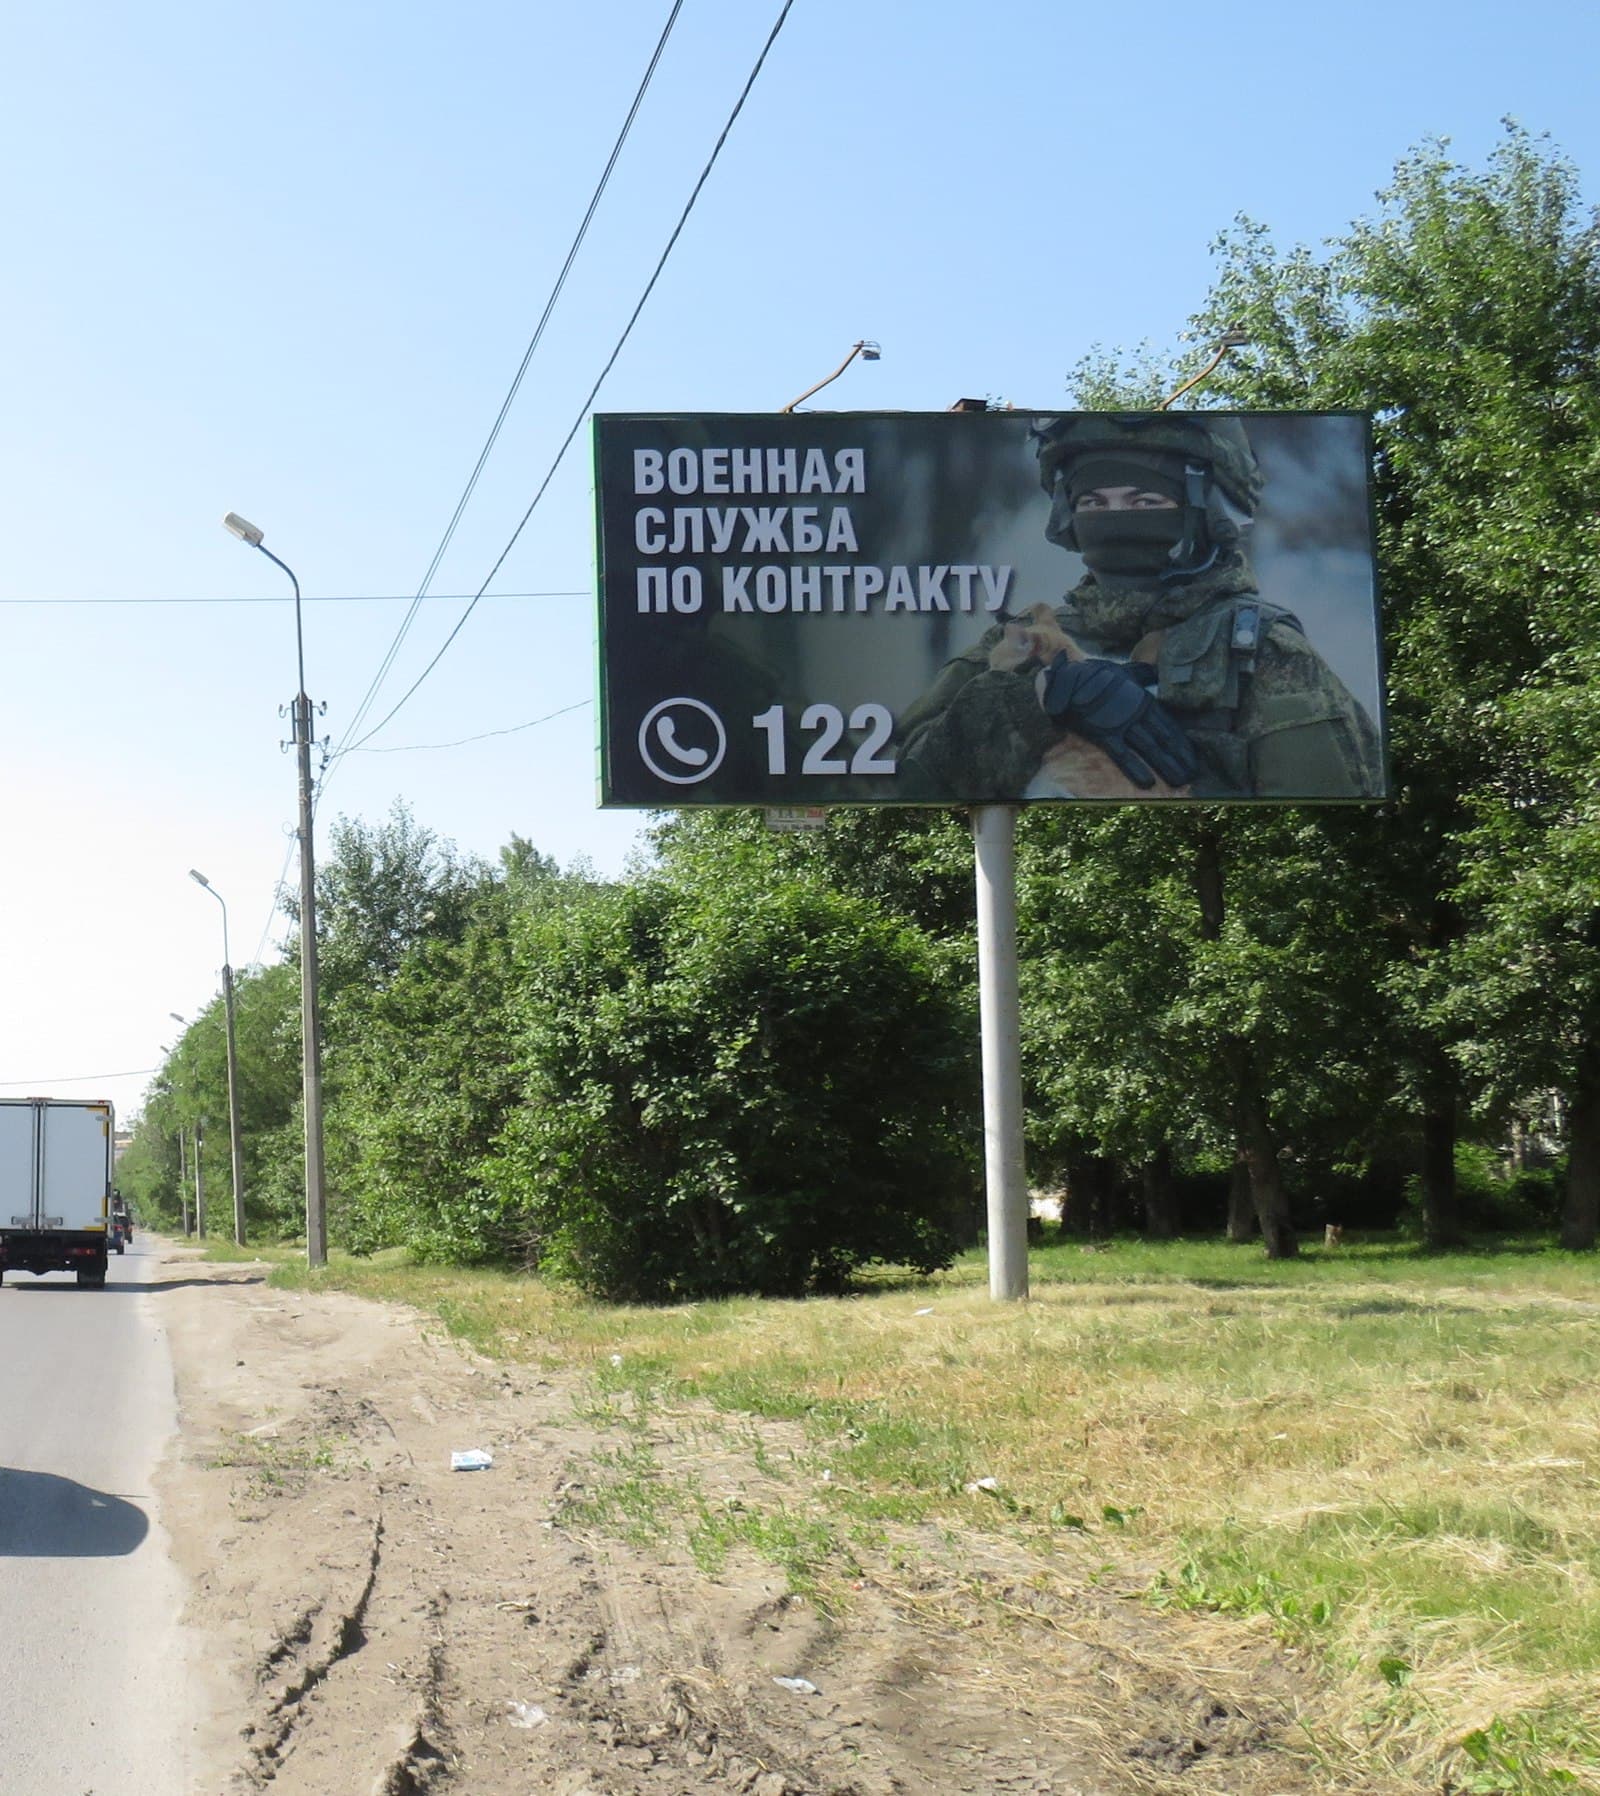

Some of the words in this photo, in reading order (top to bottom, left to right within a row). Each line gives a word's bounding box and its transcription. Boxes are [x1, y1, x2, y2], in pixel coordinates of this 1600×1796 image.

[633, 448, 866, 495] ВОЕННАЯ
[634, 506, 859, 555] СЛУЖБА
[636, 566, 703, 614] ПО
[722, 565, 1012, 613] КОНТРАКТУ
[752, 703, 896, 776] 122
